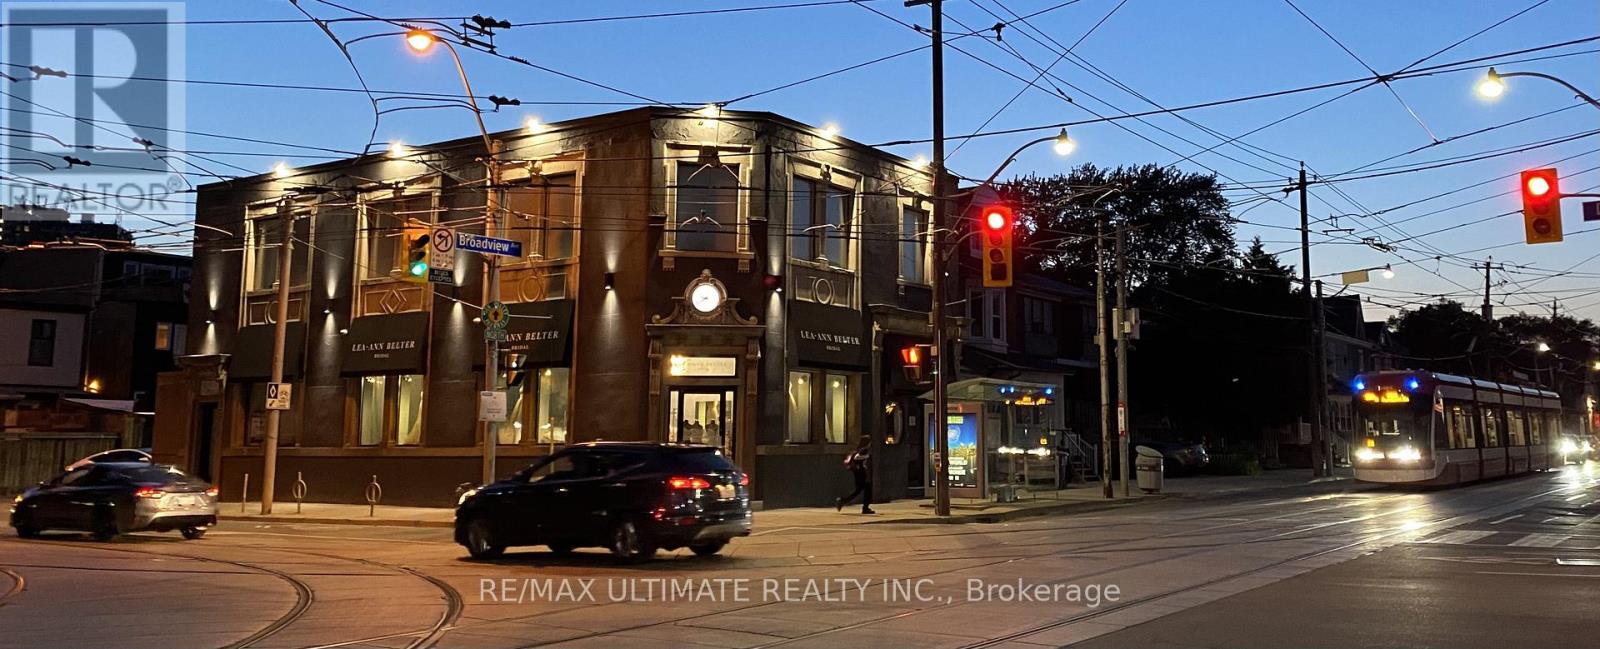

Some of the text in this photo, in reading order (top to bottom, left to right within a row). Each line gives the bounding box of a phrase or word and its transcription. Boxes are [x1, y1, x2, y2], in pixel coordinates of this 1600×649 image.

[459, 234, 509, 252] Broadview
[525, 331, 559, 341] BELTER
[386, 340, 415, 349] BELTER
